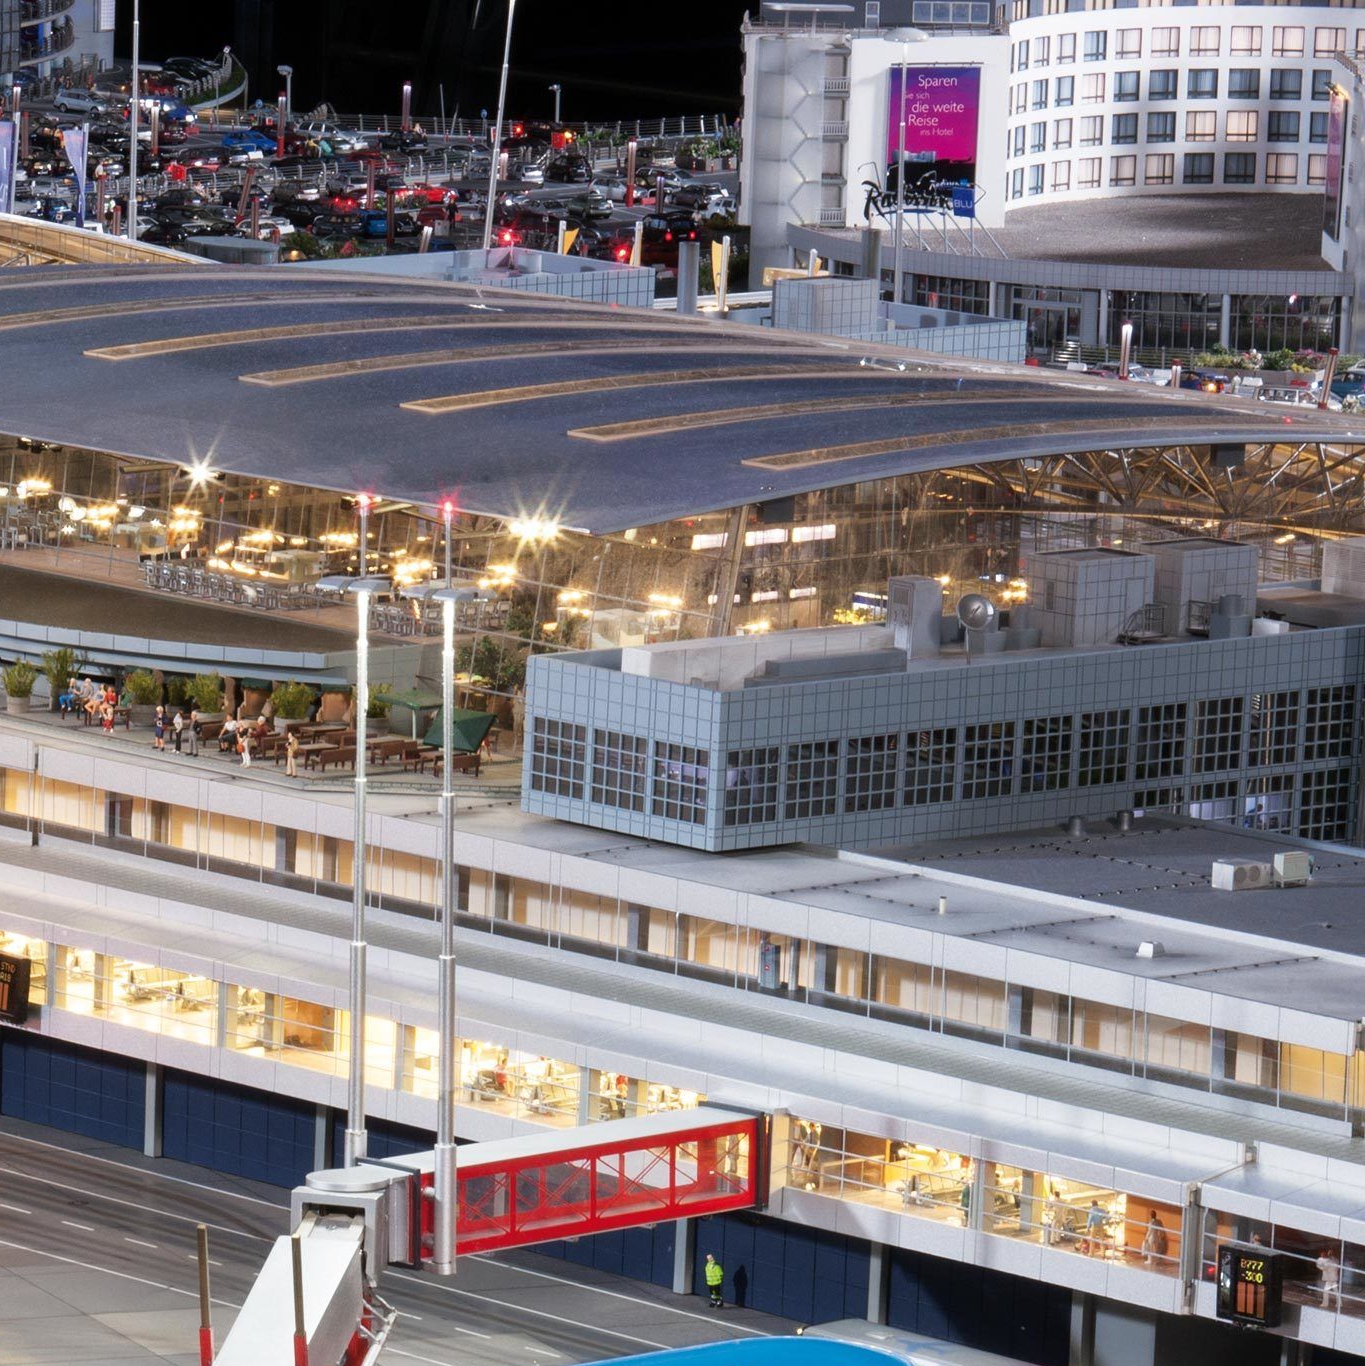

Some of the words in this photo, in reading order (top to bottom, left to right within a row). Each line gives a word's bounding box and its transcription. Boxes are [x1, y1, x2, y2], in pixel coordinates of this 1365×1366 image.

[918, 75, 957, 90] Sparen
[912, 103, 929, 113] die
[933, 103, 964, 113] weite
[908, 114, 939, 126] Reise
[932, 128, 954, 137] Hotel
[954, 199, 973, 209] BLU
